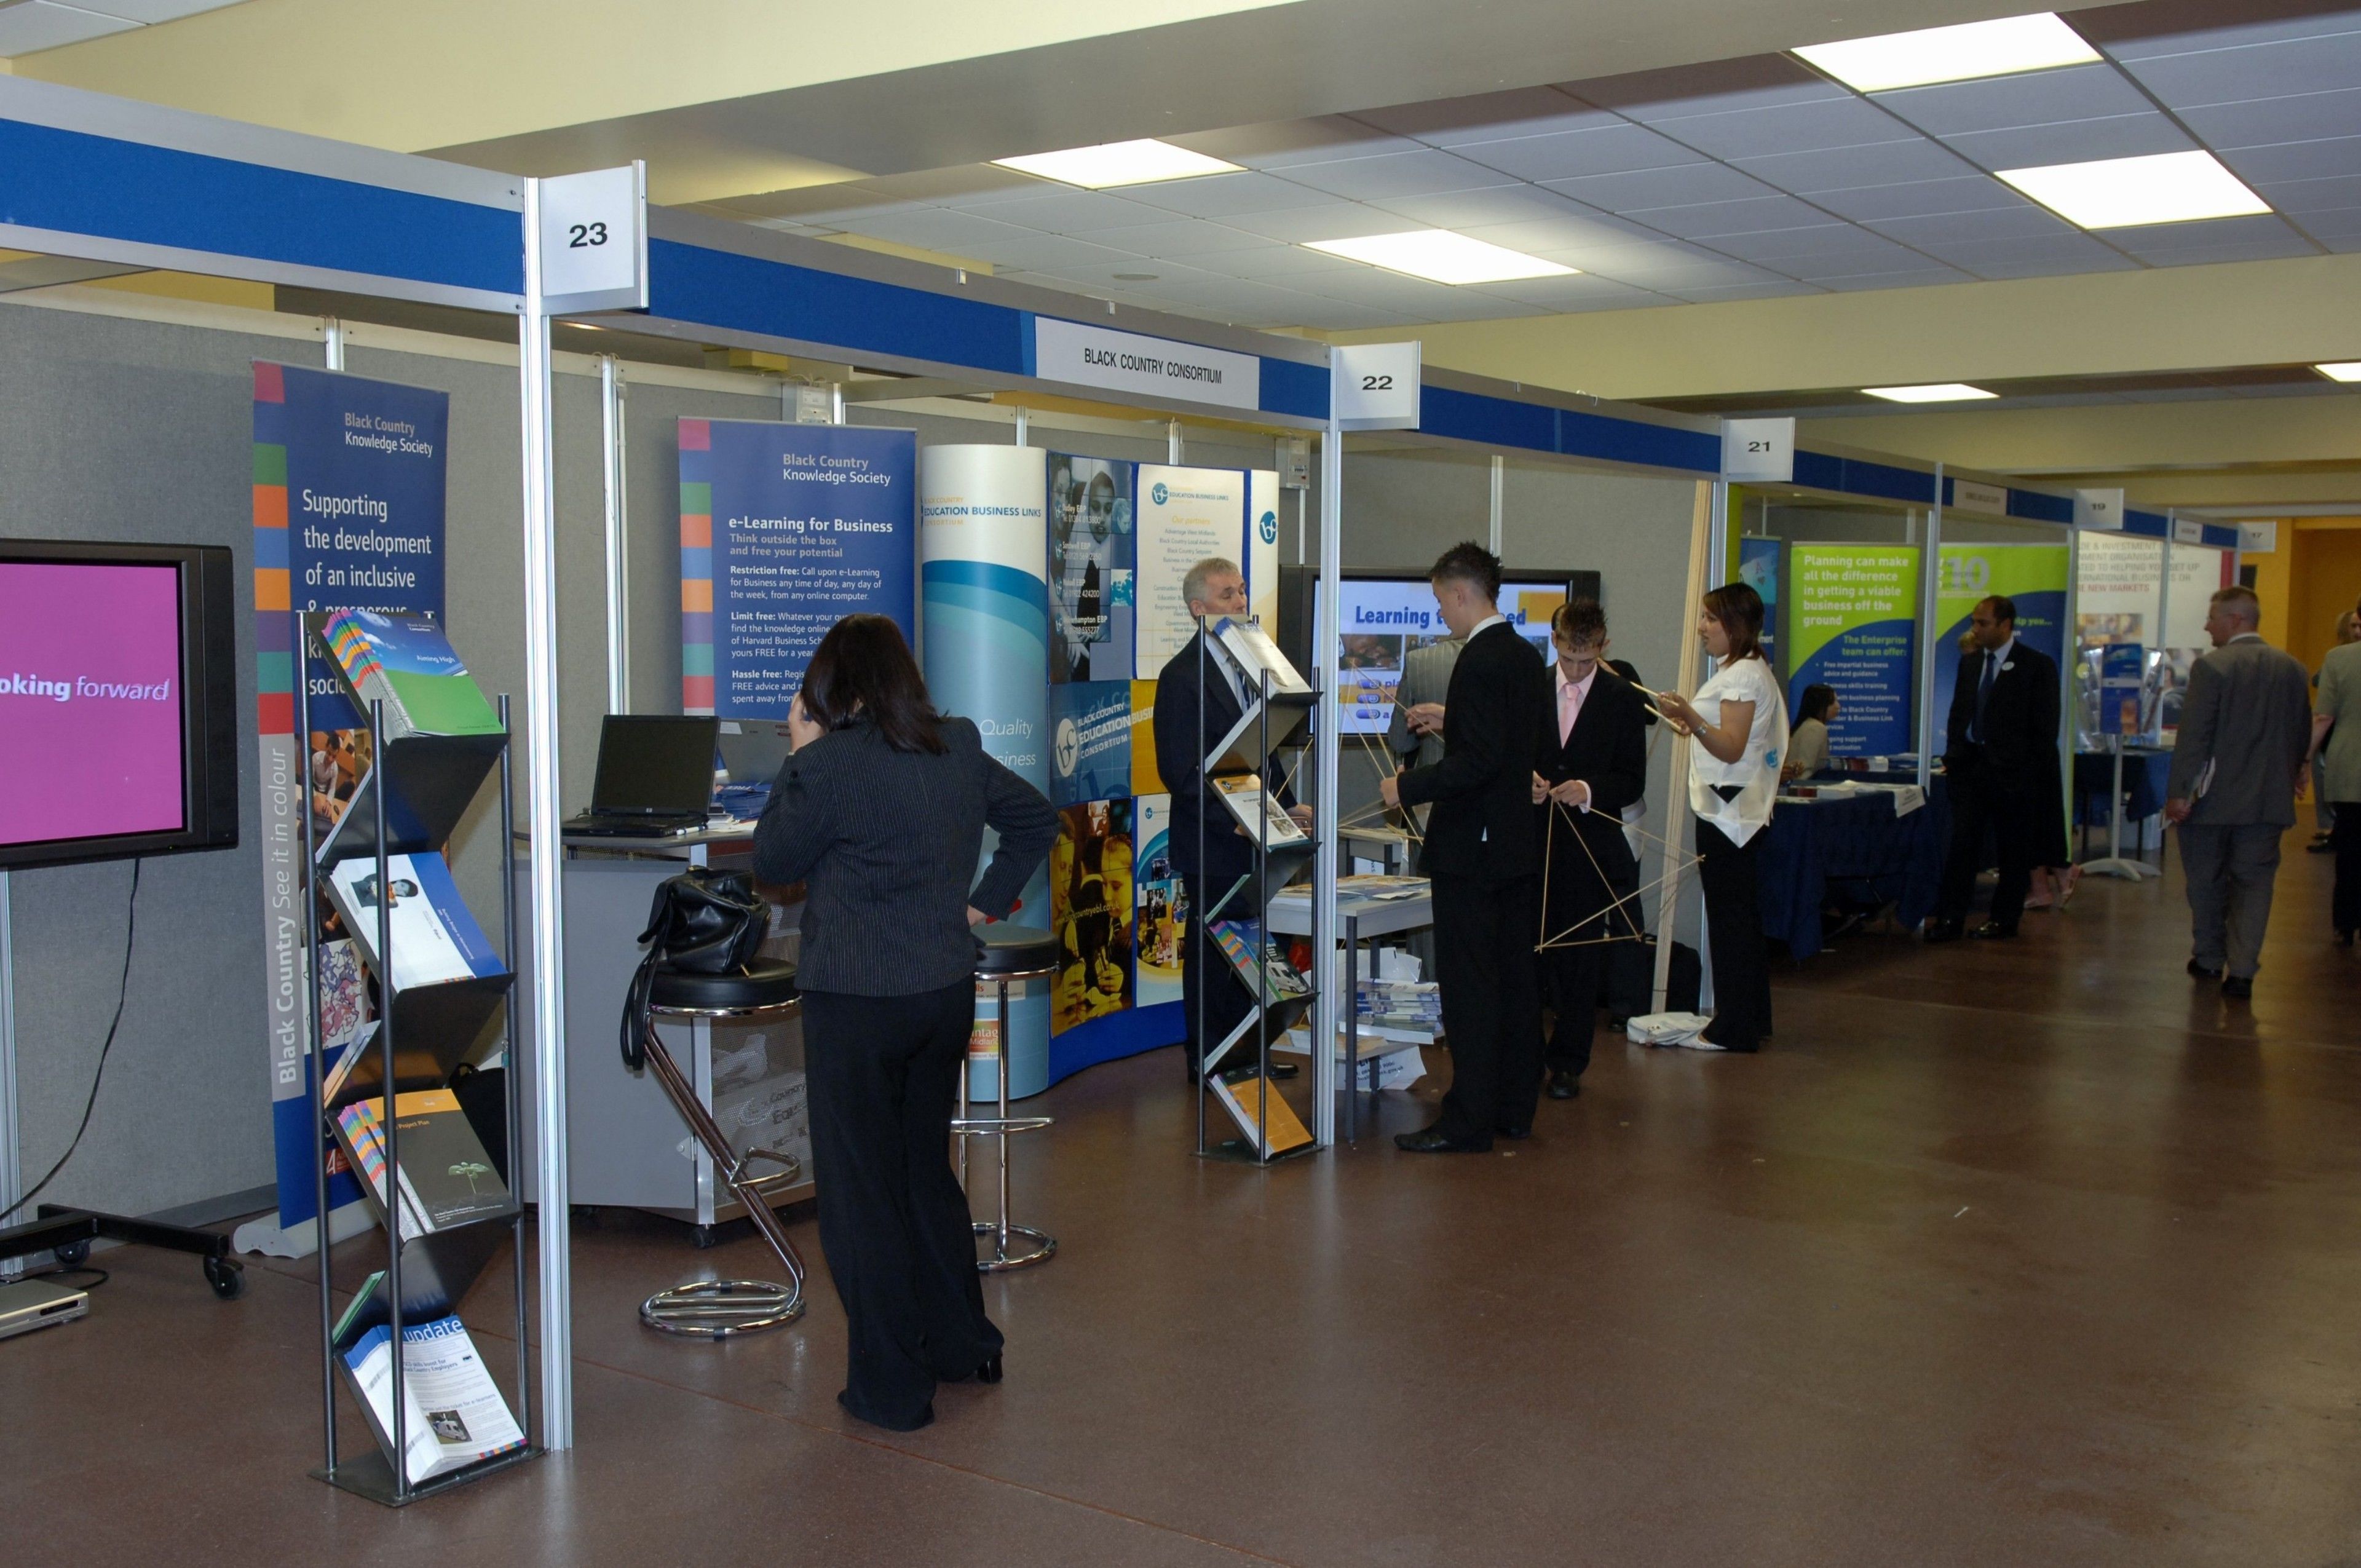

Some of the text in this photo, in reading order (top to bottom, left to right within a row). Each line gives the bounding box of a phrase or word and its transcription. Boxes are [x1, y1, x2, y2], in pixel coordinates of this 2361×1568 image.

[569, 223, 607, 248] 23
[1085, 348, 1222, 384] BLACK COUNTRY CONSORTIUM
[1362, 376, 1393, 390] 22
[345, 413, 414, 437] Black Country
[346, 432, 433, 457] Knowledge Society
[1748, 441, 1770, 452] 21
[783, 454, 868, 471] Black Country
[783, 469, 890, 486] Knowledge Society
[303, 489, 387, 523] Supporting
[925, 507, 1040, 517] EDUCATION BUSINESS LINKS
[729, 516, 893, 533] e-Learning for Business
[304, 525, 432, 558] the development
[730, 534, 836, 545] Think outside the box
[730, 546, 842, 558] and free your potential
[1804, 555, 1908, 568] Planning can make
[306, 562, 415, 587] of an inclusive
[730, 566, 777, 575] Restriction
[780, 566, 799, 575] free:
[818, 569, 837, 578] upon
[839, 568, 880, 578] e-Learning
[1803, 571, 1898, 581] all the difference
[1947, 555, 1990, 591] 10
[825, 580, 839, 589] day,
[842, 581, 855, 590] any
[858, 580, 871, 590] day
[874, 580, 882, 588] of
[1804, 585, 1813, 595] in
[1817, 586, 1854, 598] getting
[1869, 586, 1901, 596] viable
[2110, 584, 2149, 592] MARKETS
[746, 591, 767, 600] week,
[791, 592, 805, 601] any
[832, 592, 869, 601] computer.
[1803, 601, 1892, 611] business off the
[731, 612, 753, 620] Limit
[756, 612, 775, 620] free:
[816, 614, 832, 622] your
[1356, 606, 1430, 629] Learning
[1803, 616, 1842, 627] ground
[765, 624, 805, 634] knowledge
[1862, 635, 1907, 646] Enterprise
[732, 650, 753, 659] yours
[785, 671, 805, 679] Regis
[0, 673, 170, 702] oking forward
[756, 696, 775, 705] away
[1078, 702, 1125, 727] BLACK COUNTRY
[980, 718, 1032, 738] Quality
[1079, 715, 1131, 744] EDUCATION
[1081, 734, 1128, 759] CONSORTIUM
[995, 751, 1036, 766] siness
[267, 748, 297, 1084] Black Country See it in colour
[404, 1319, 464, 1342] update
